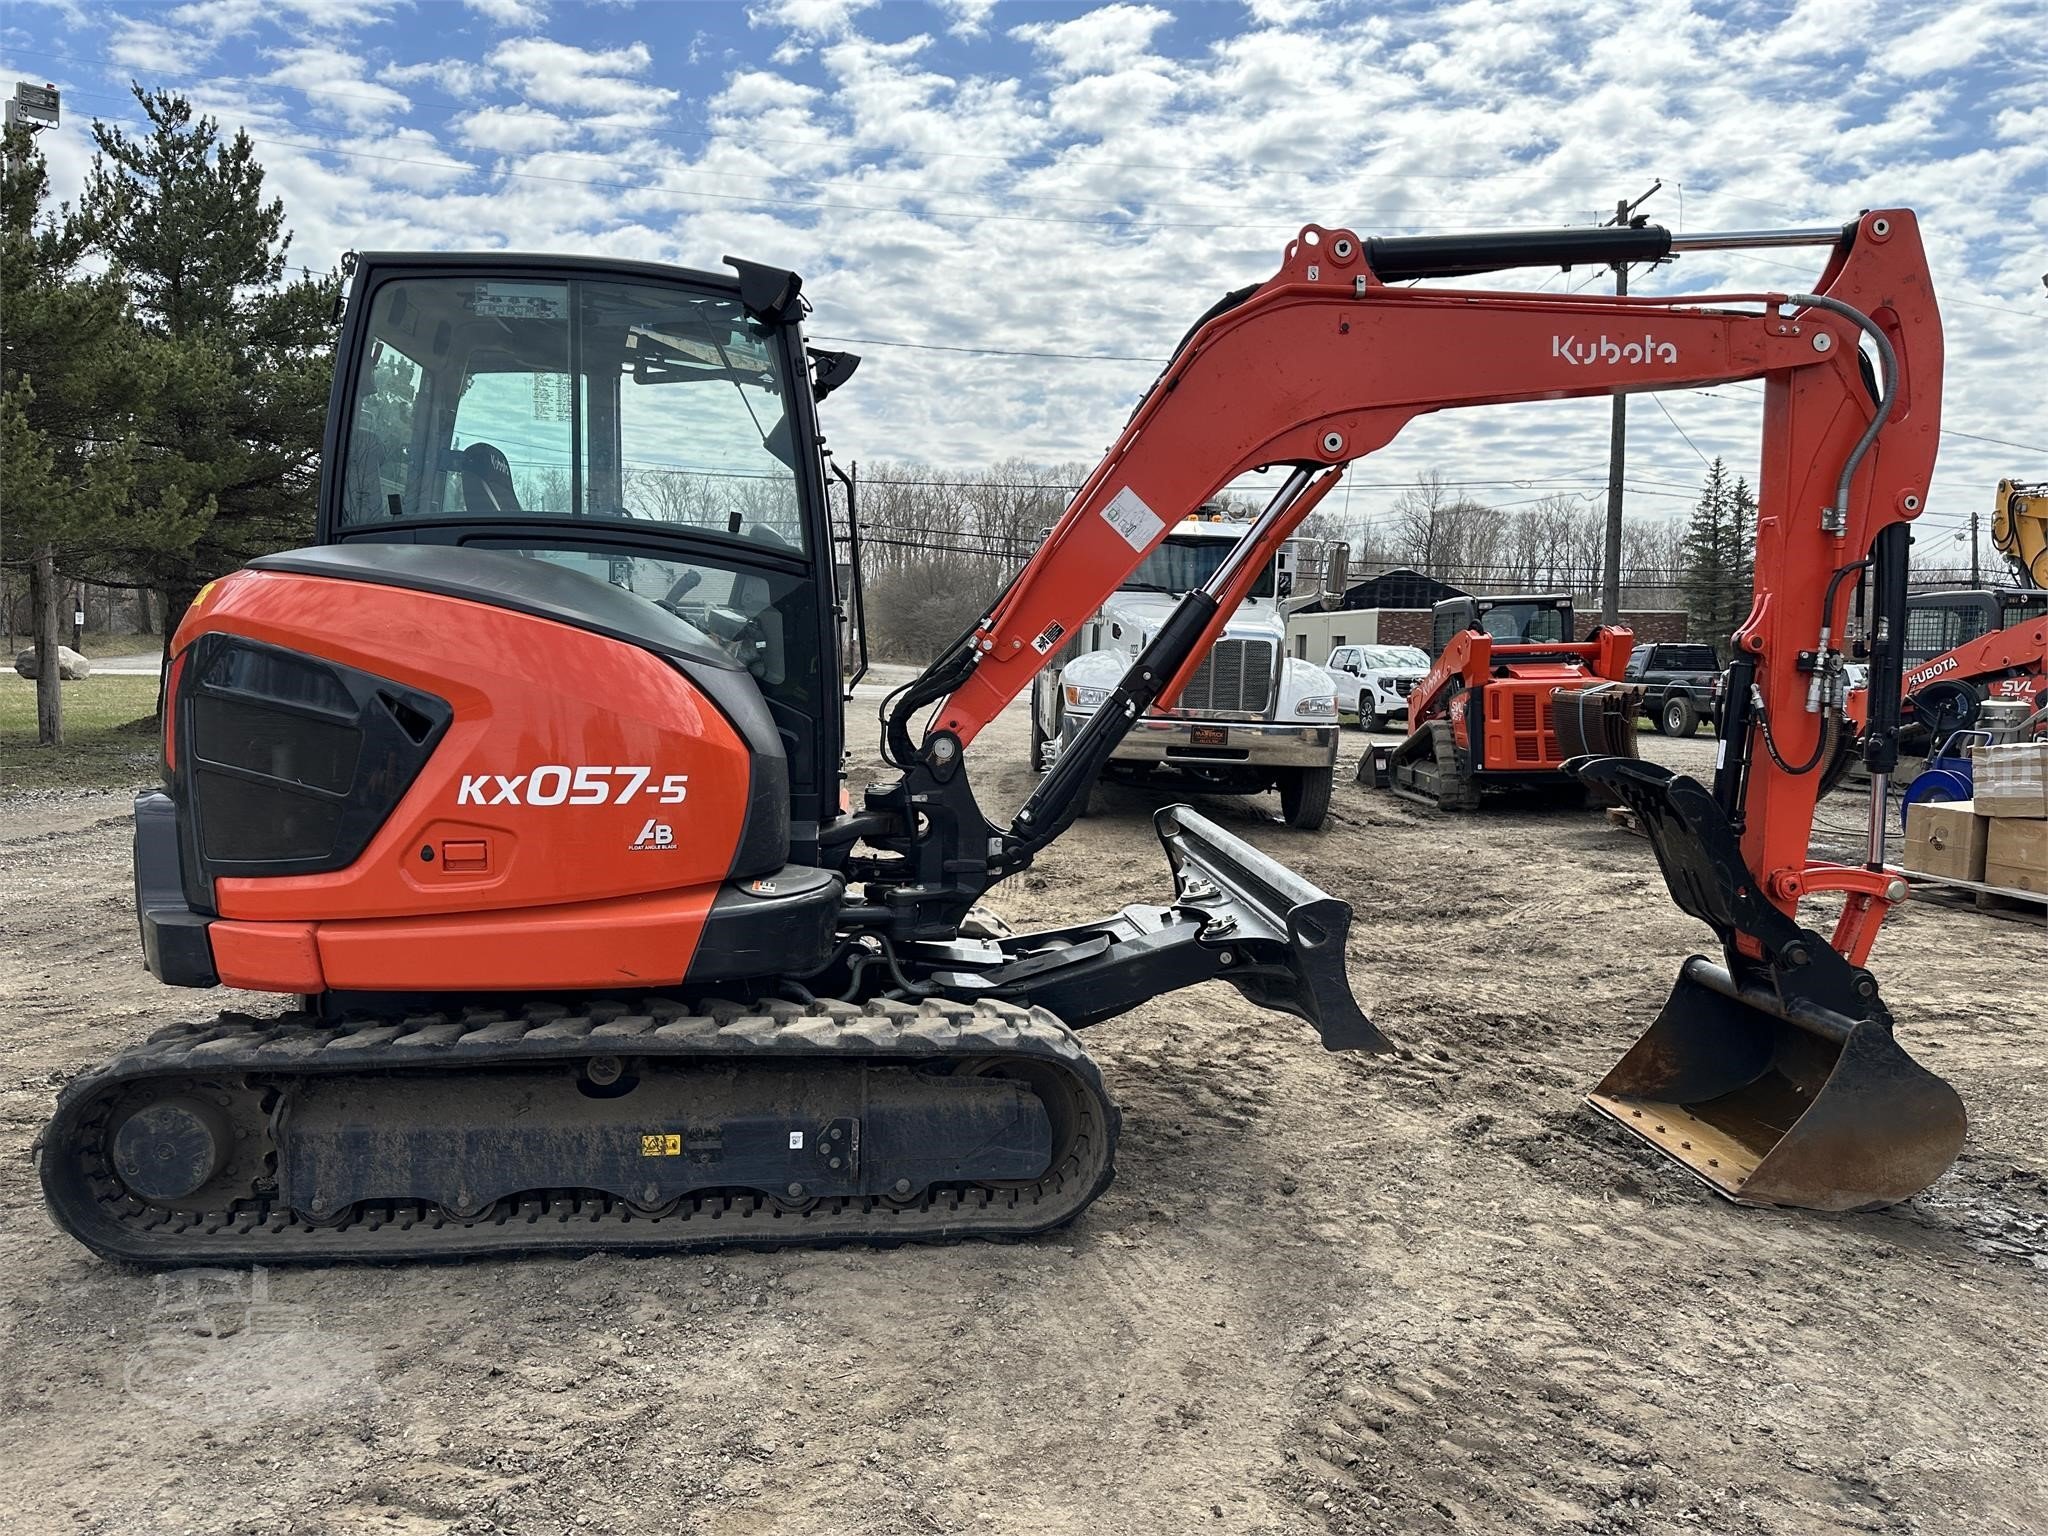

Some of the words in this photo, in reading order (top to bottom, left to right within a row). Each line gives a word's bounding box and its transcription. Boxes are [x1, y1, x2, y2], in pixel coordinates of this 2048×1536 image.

[1552, 334, 1677, 365] Kubota
[1999, 680, 2037, 693] SVL
[457, 765, 688, 806] KX057-5
[634, 819, 673, 845] AB
